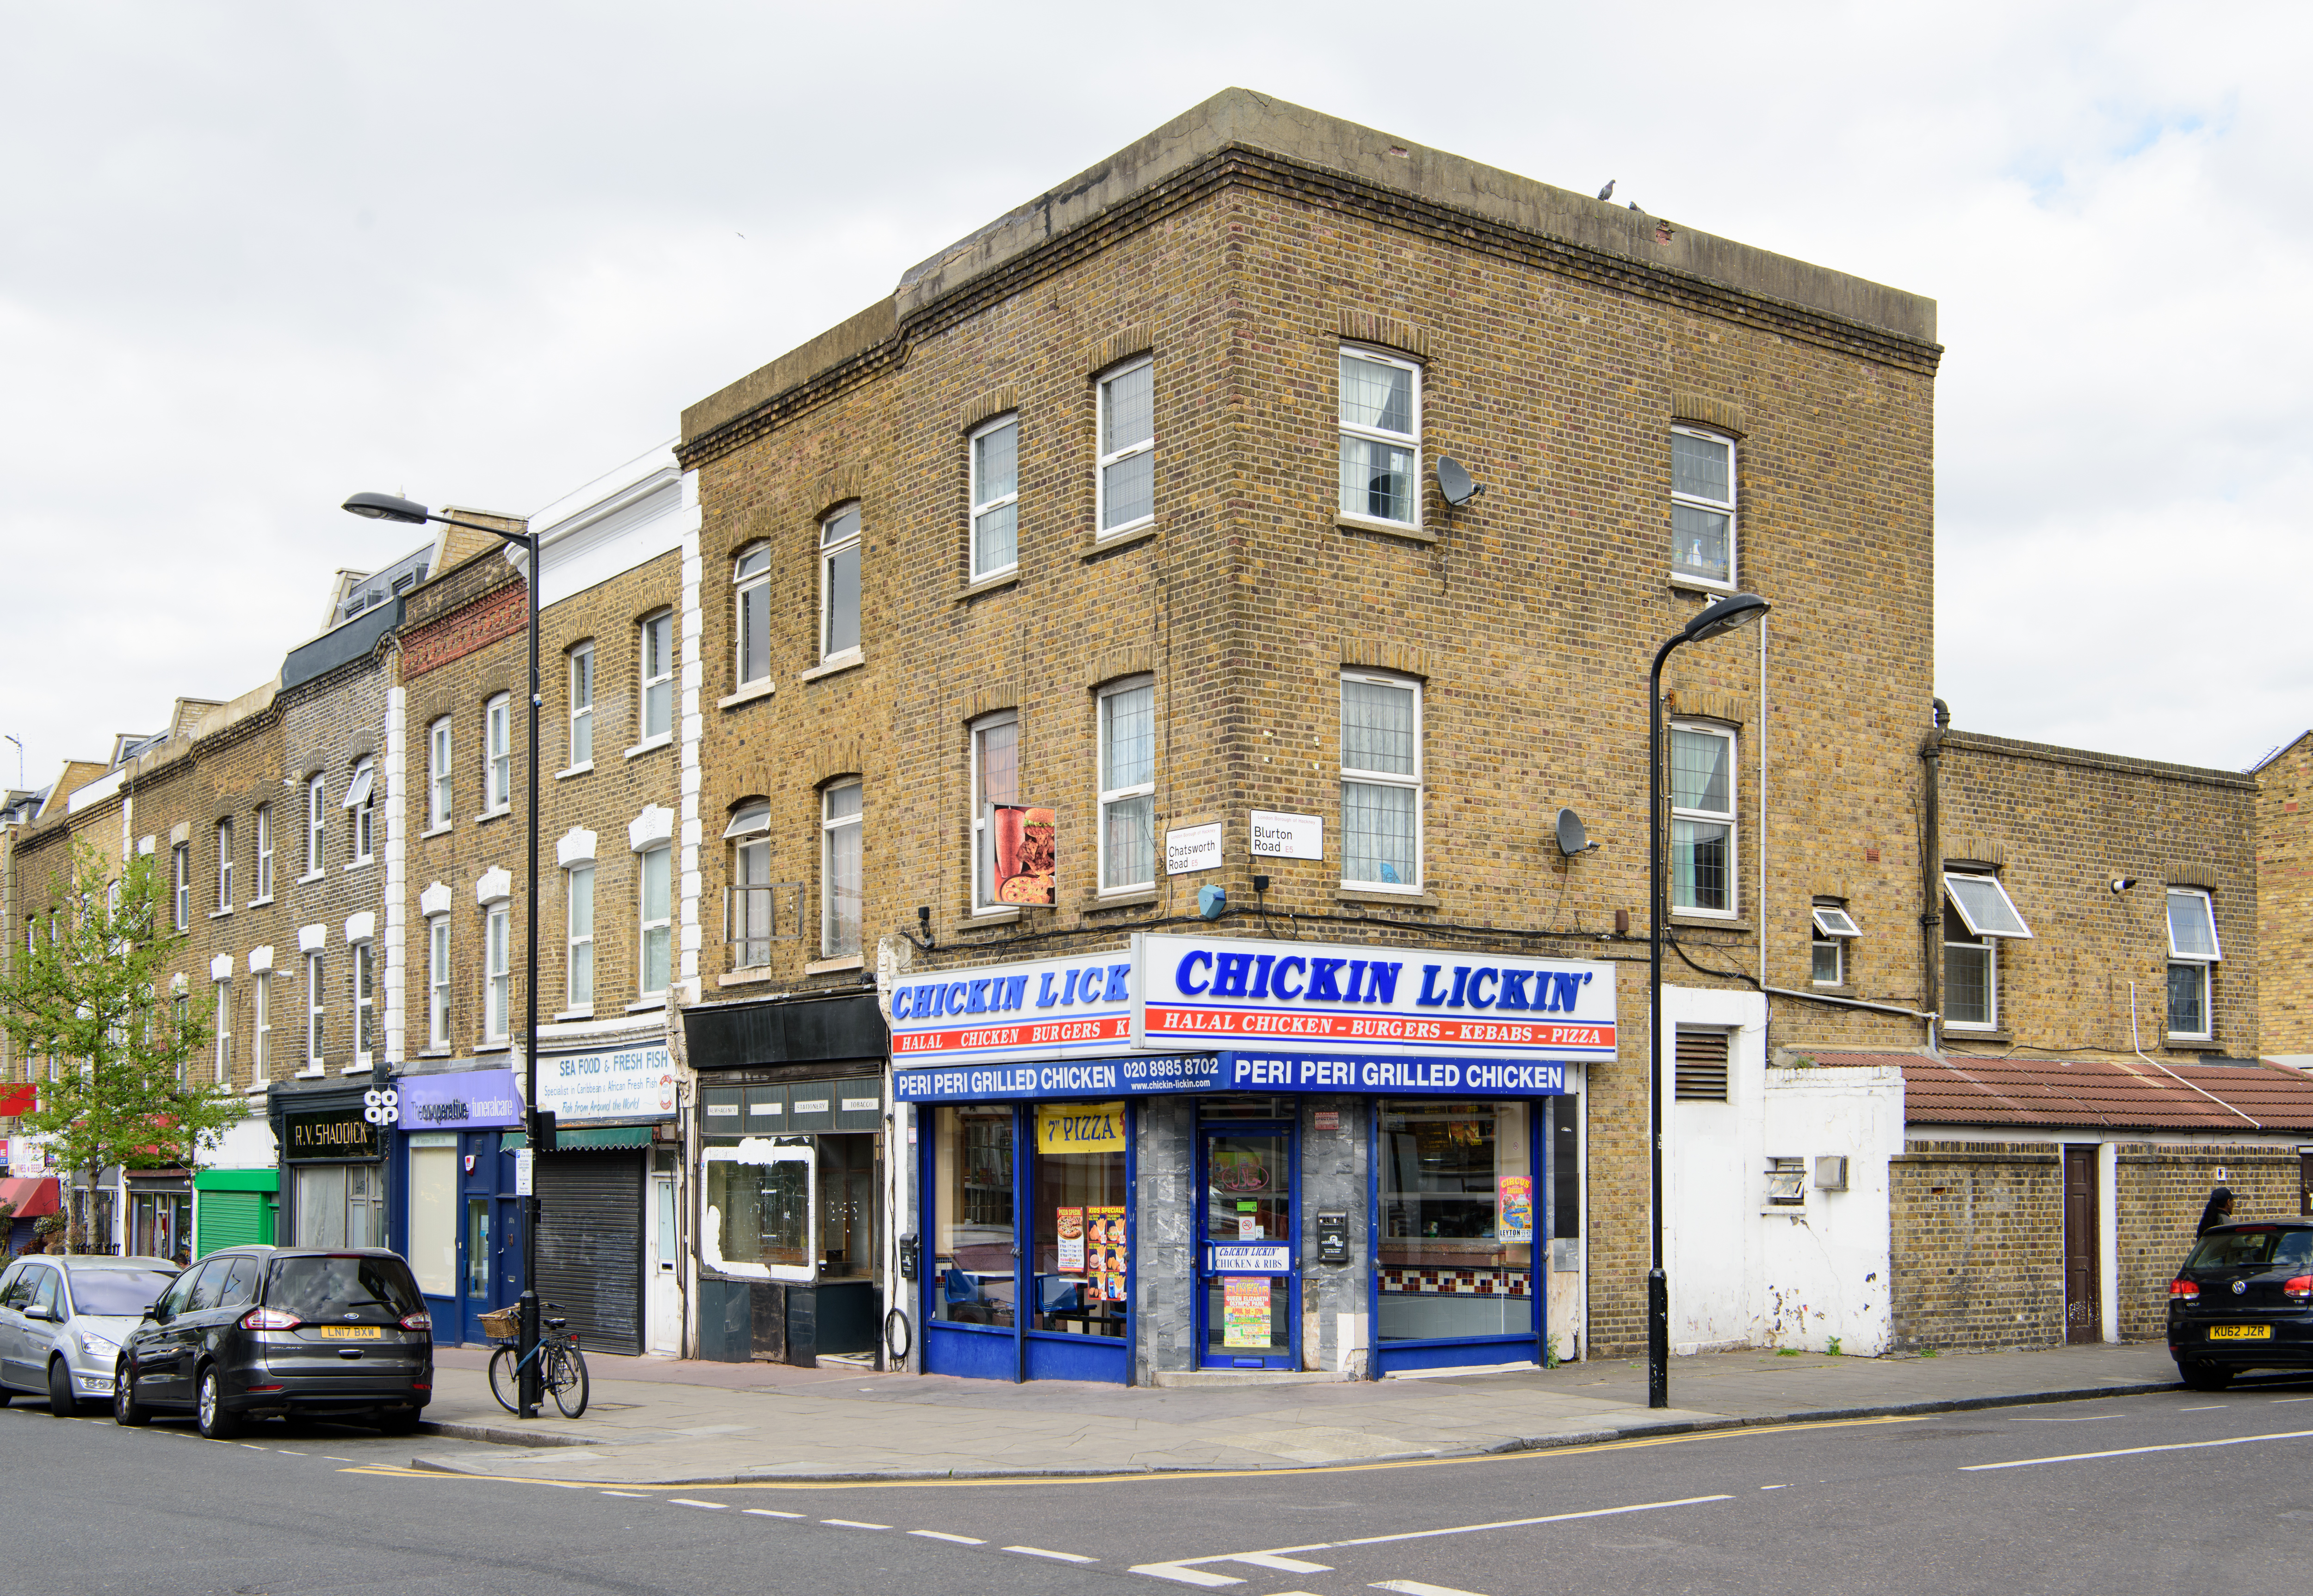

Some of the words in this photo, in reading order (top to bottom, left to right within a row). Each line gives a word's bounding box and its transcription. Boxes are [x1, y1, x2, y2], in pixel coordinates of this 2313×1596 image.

[1254, 826, 1292, 840] Blurton
[1169, 840, 1215, 858] Chatsworth
[1254, 839, 1280, 852] Road
[1169, 857, 1188, 870] Road
[1175, 950, 1403, 1004] CHICKIN
[1416, 964, 1593, 1012] LICKIN'
[892, 975, 1028, 1019] CHICKIN
[1164, 1012, 1235, 1029] HALAL
[1242, 1015, 1333, 1033] CHICKEN
[1350, 1020, 1441, 1038] BURGERS
[1460, 1024, 1532, 1041] KEBABS
[1551, 1028, 1601, 1043] PIZZA
[902, 1034, 943, 1051] HALAL
[961, 1028, 1019, 1047] CHICKEN
[1032, 1022, 1101, 1042] BURGERS
[560, 1060, 575, 1077] SEA
[579, 1057, 600, 1075] FOOD
[604, 1060, 610, 1072] &
[613, 1053, 642, 1071] FRESH
[646, 1050, 668, 1068] FISH
[899, 1075, 931, 1096] PERI
[934, 1072, 968, 1094] PERI
[971, 1068, 1037, 1092] GRILLED
[1041, 1065, 1116, 1090] CHICKEN
[1124, 1061, 1147, 1078] 020
[1150, 1060, 1182, 1077] 8985
[1185, 1058, 1218, 1075] 8702
[1235, 1060, 1292, 1084] PERI
[1301, 1060, 1355, 1085] PERI
[1362, 1063, 1460, 1087] GRILLED
[1466, 1065, 1562, 1089] CHICKEN
[544, 1085, 569, 1098] Specialist
[571, 1085, 575, 1094] in
[577, 1083, 601, 1094] Caribbean
[608, 1081, 625, 1092] African
[628, 1078, 643, 1090] Fresh
[646, 1077, 657, 1089] Fish
[1131, 1078, 1211, 1091] www.chickin-lickin.com
[472, 1096, 513, 1118] funeralcare
[562, 1102, 572, 1114] Fish
[574, 1101, 588, 1113] from
[590, 1099, 611, 1111] Around
[612, 1098, 621, 1110] the
[623, 1097, 640, 1110] World
[797, 1103, 826, 1111] STATIONERY
[316, 1122, 367, 1145] SHADDICK
[1063, 1114, 1116, 1142] PIZZA
[16, 1164, 26, 1173] WINES
[31, 1164, 42, 1173] BEERS
[1501, 1177, 1530, 1189] CIRCUS
[1251, 1247, 1279, 1256] LICKIN'
[1215, 1259, 1251, 1268] CHICKEN
[1255, 1259, 1260, 1268] &
[1264, 1259, 1282, 1268] RIBS
[1226, 1285, 1269, 1296] FUNFAIR
[328, 1327, 351, 1337] LN17
[354, 1328, 374, 1337] BXW
[2214, 1326, 2240, 1337] KU62
[2244, 1326, 2264, 1336] JZR
